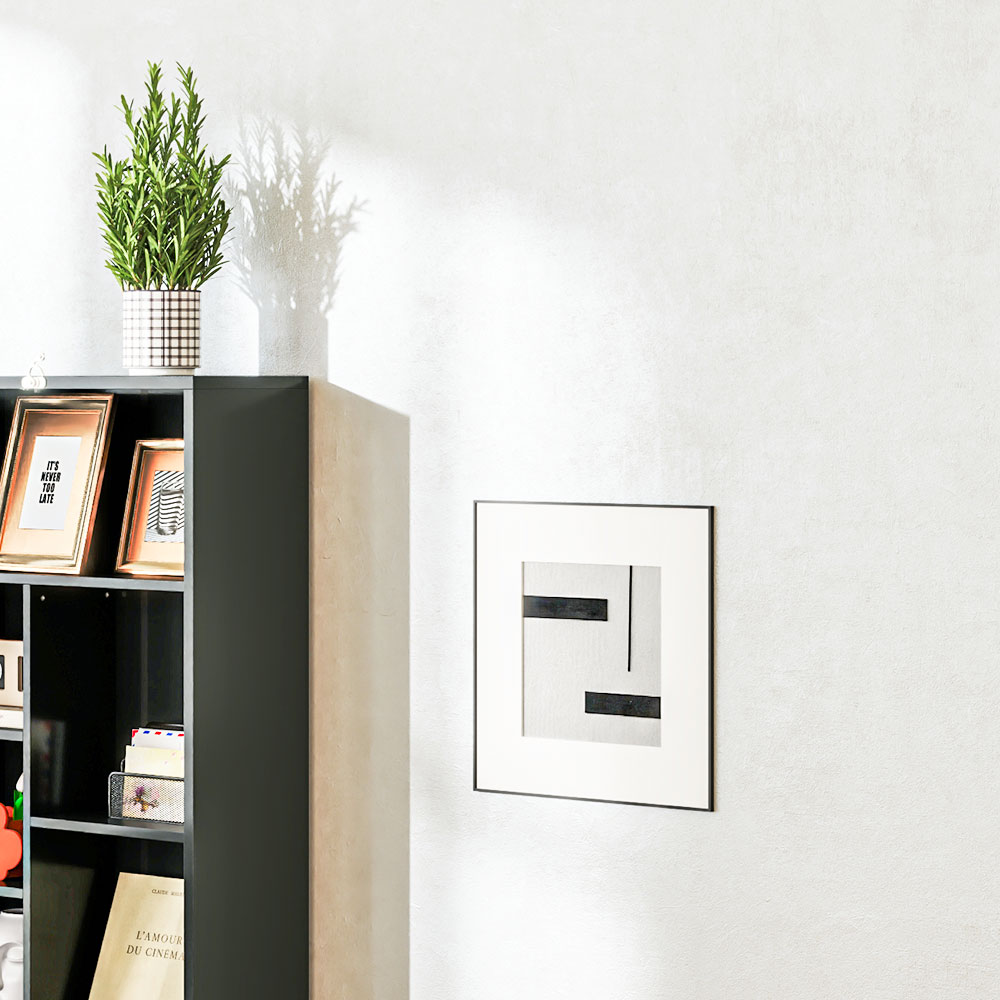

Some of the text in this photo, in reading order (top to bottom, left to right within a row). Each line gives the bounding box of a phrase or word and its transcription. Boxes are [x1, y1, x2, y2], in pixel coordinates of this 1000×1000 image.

[46, 460, 60, 471] IT'S
[40, 472, 61, 482] NEVER
[42, 482, 55, 493] TOO
[39, 493, 54, 504] LATE
[136, 930, 182, 945] L'AMOUR
[126, 944, 142, 955] DU
